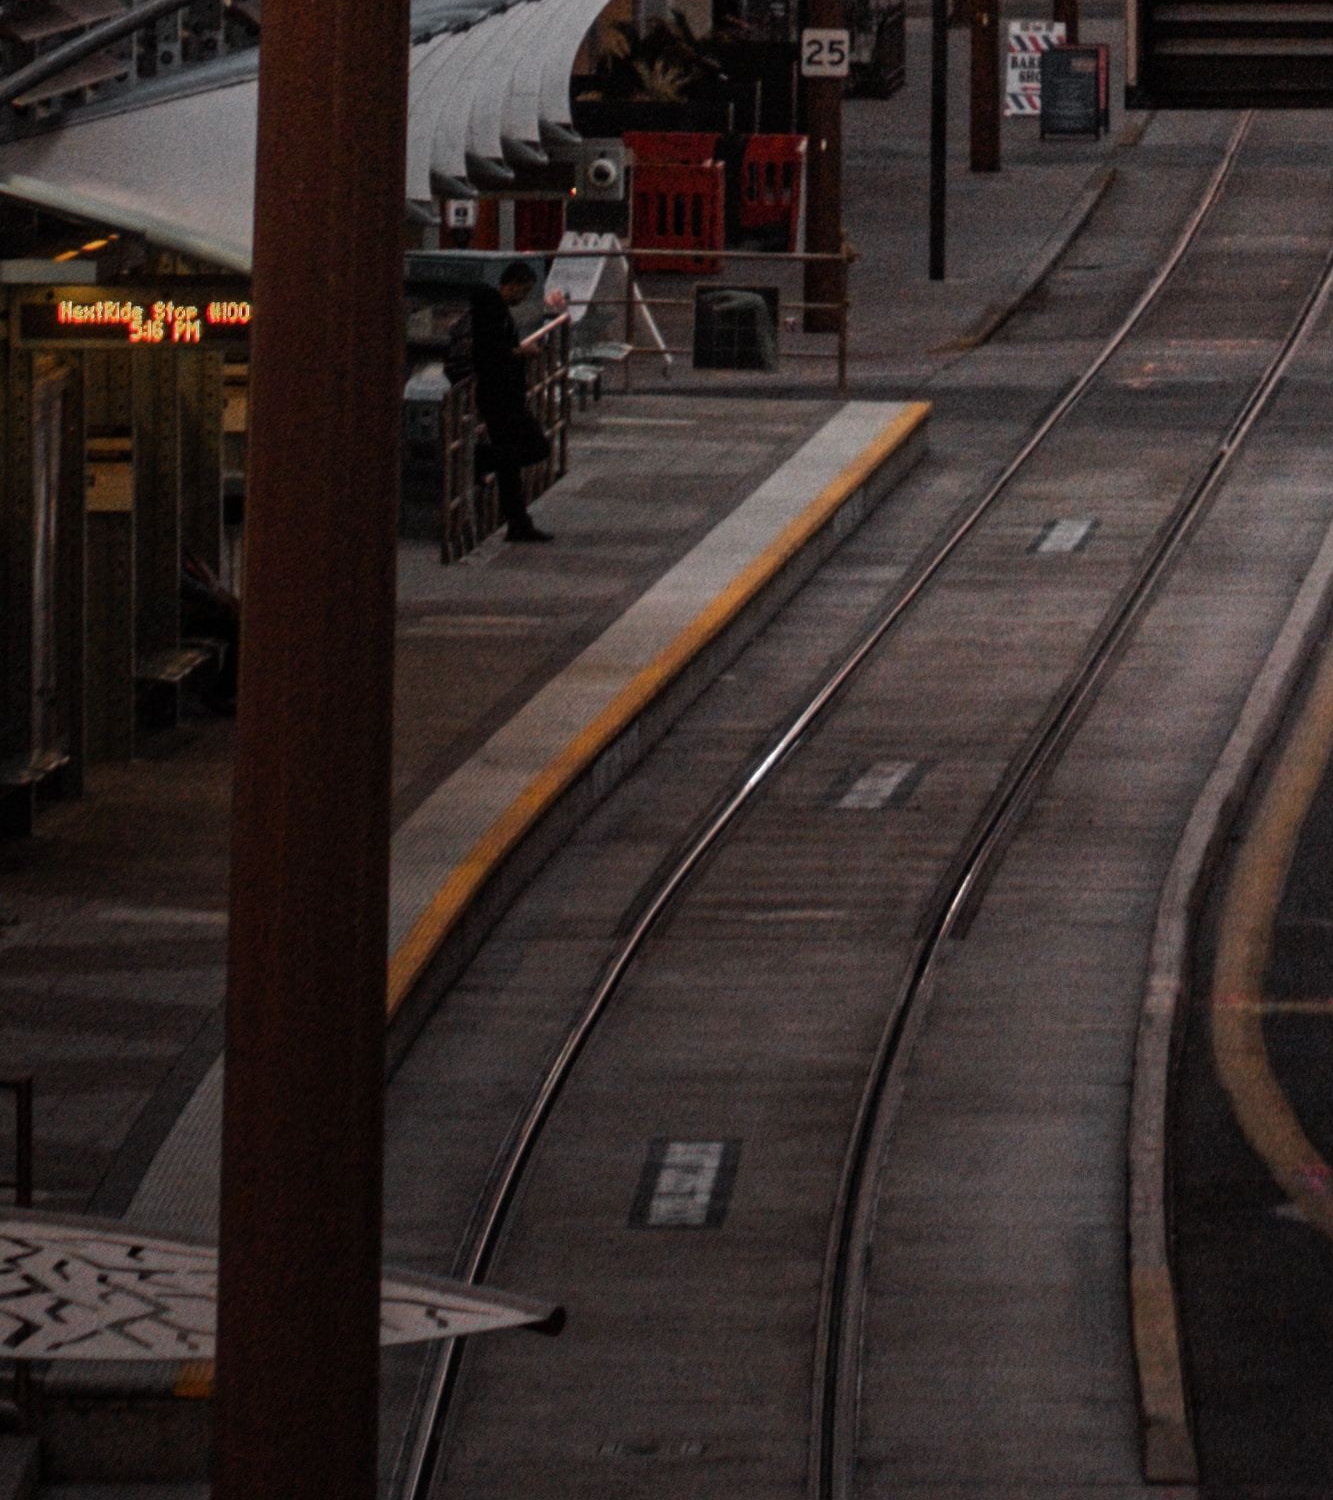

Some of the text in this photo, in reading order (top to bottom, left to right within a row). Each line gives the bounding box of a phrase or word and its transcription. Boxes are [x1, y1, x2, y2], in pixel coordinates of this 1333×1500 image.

[807, 38, 846, 67] 25
[151, 300, 199, 323] Stop
[171, 320, 202, 343] PM
